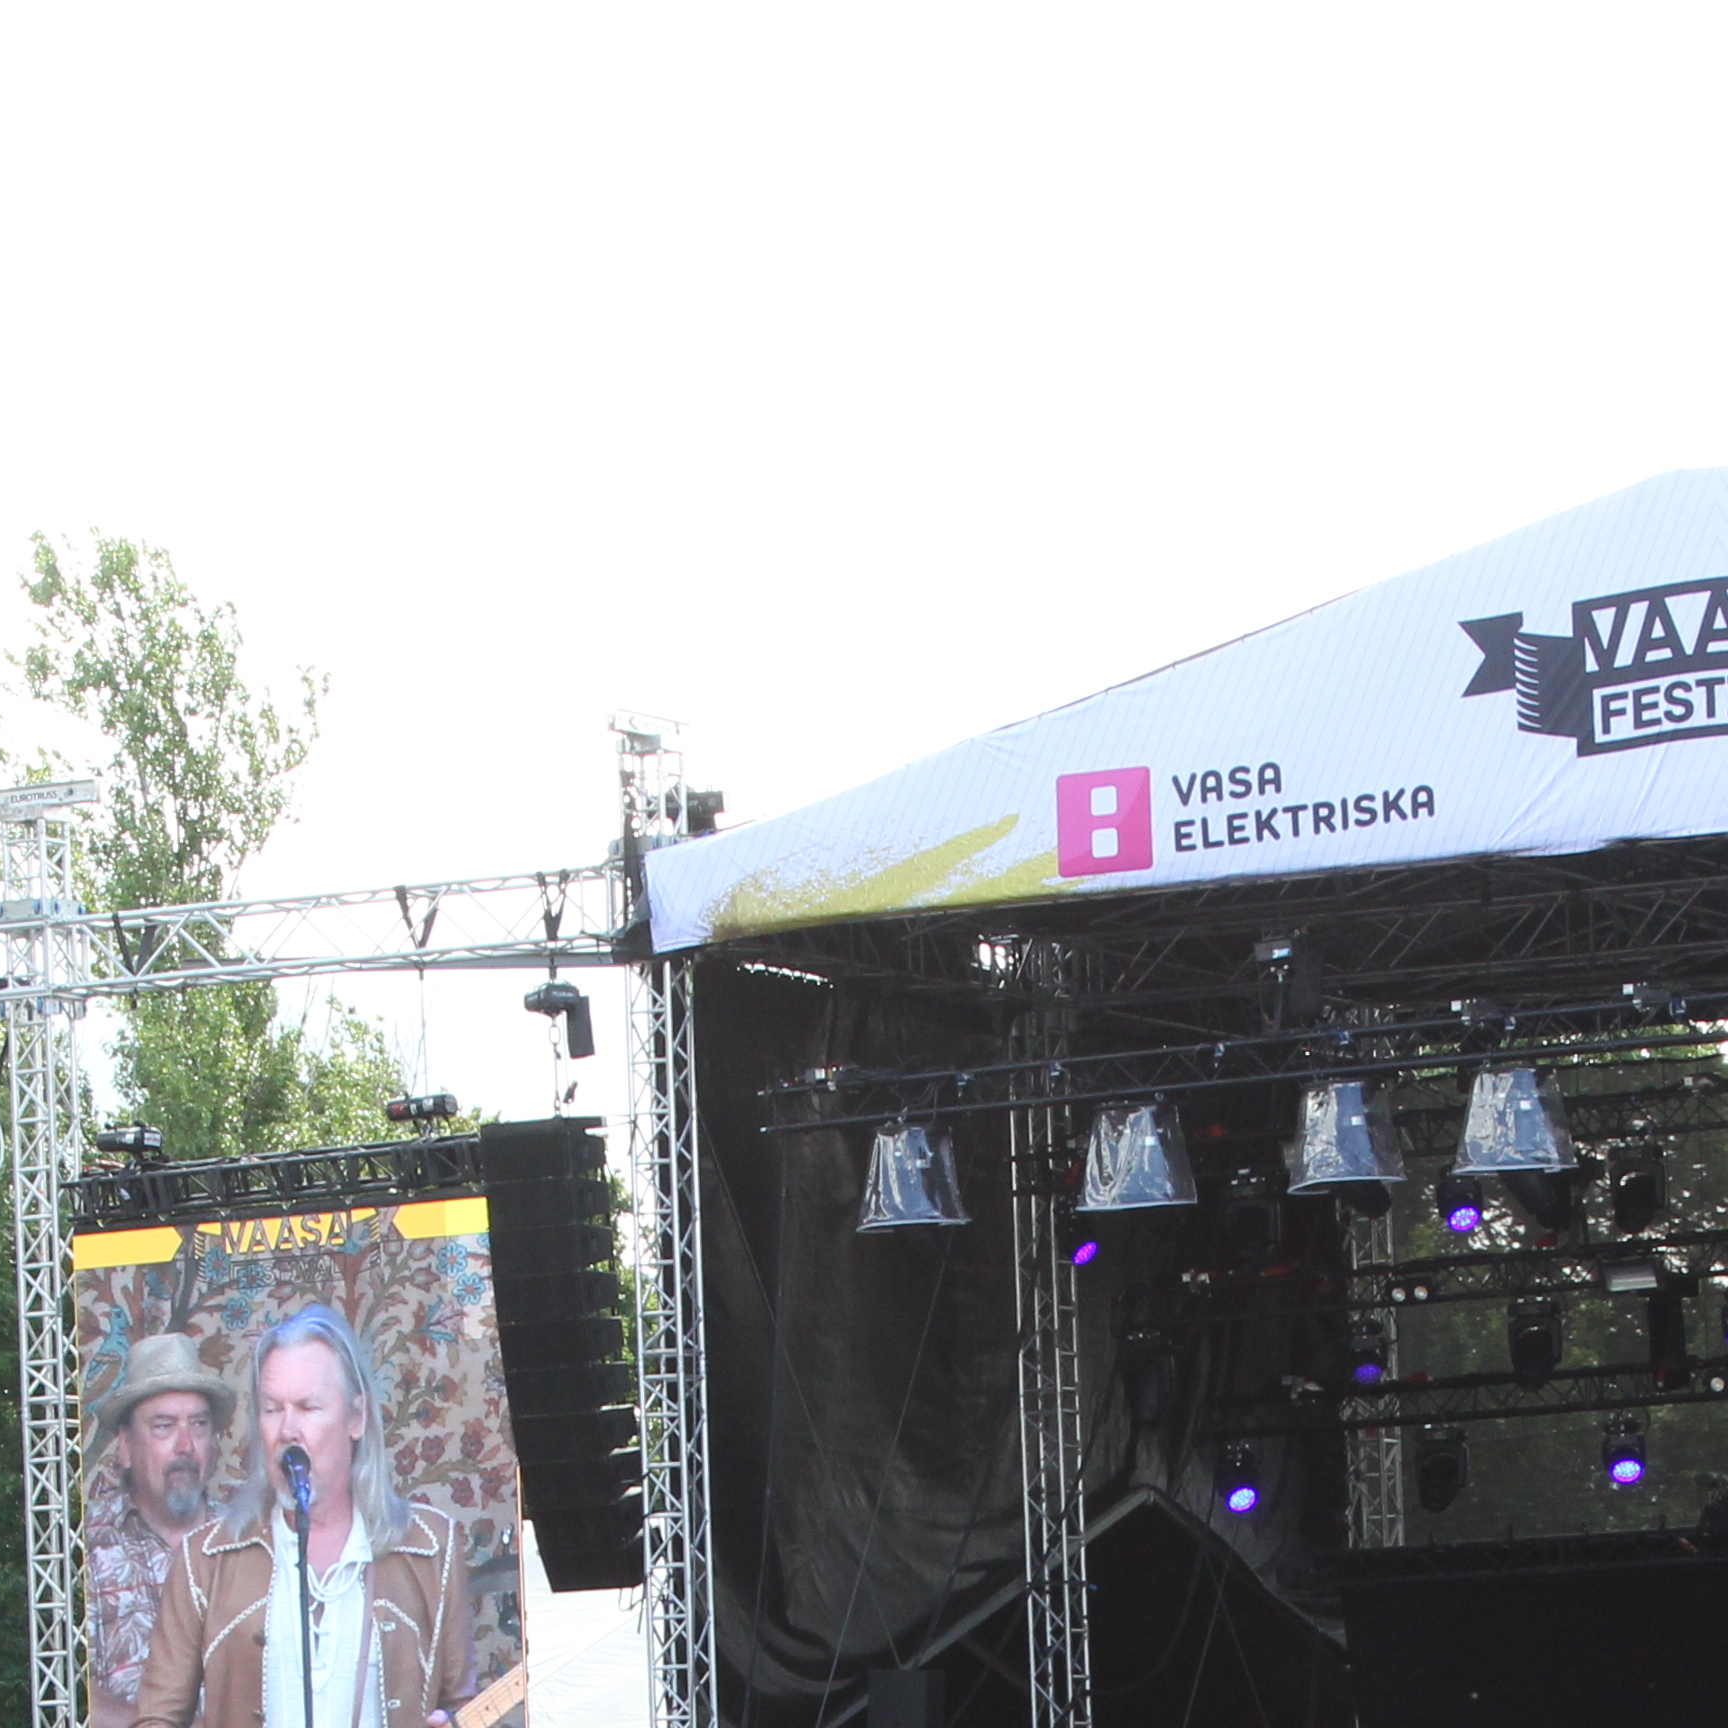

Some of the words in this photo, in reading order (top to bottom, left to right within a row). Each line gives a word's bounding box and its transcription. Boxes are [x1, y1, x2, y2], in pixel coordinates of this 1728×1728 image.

[1172, 761, 1282, 807] VASA
[1173, 784, 1436, 853] ELEKTRISKA
[224, 1211, 348, 1255] VAASA
